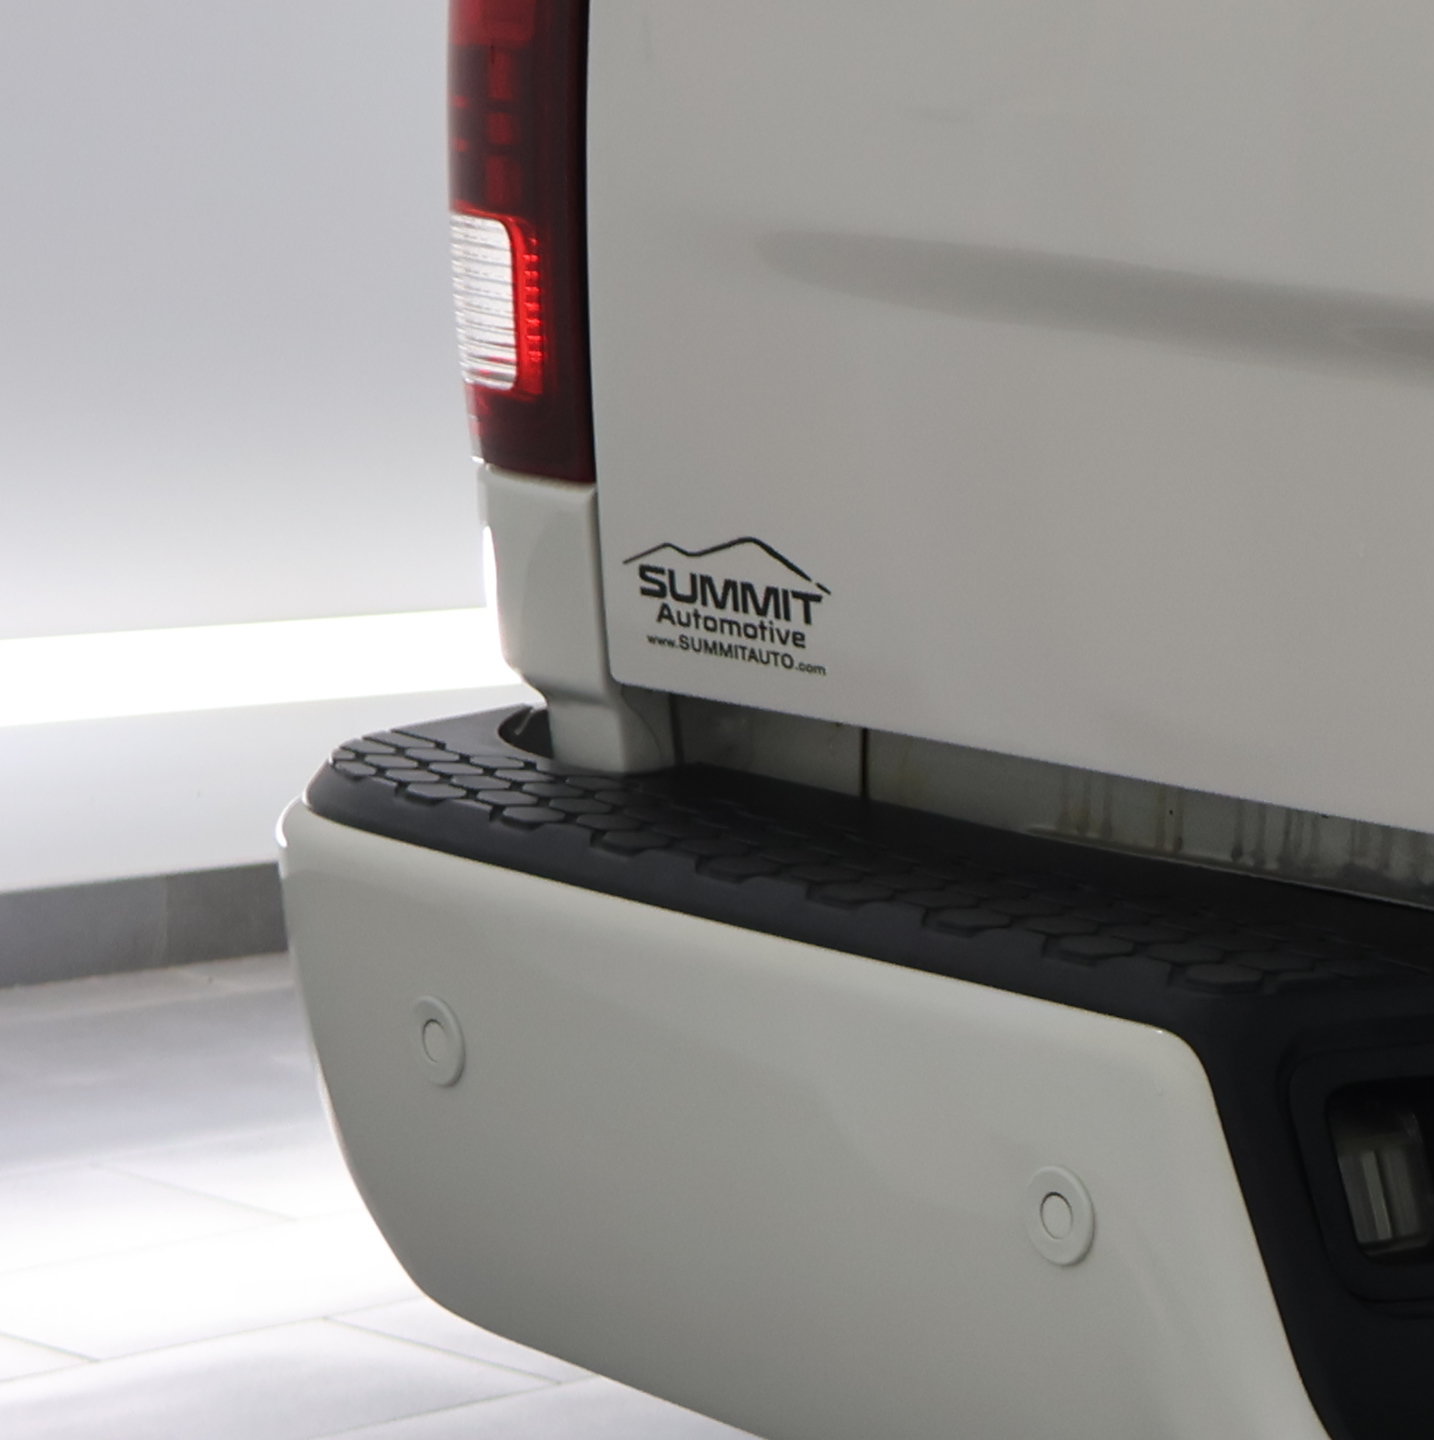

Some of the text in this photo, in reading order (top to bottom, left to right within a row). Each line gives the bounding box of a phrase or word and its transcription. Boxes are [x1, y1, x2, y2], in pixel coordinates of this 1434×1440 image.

[637, 563, 823, 626] SUMMIT
[655, 601, 807, 649] Automotive
[645, 632, 828, 677] www.SUMMITAUTO.com
